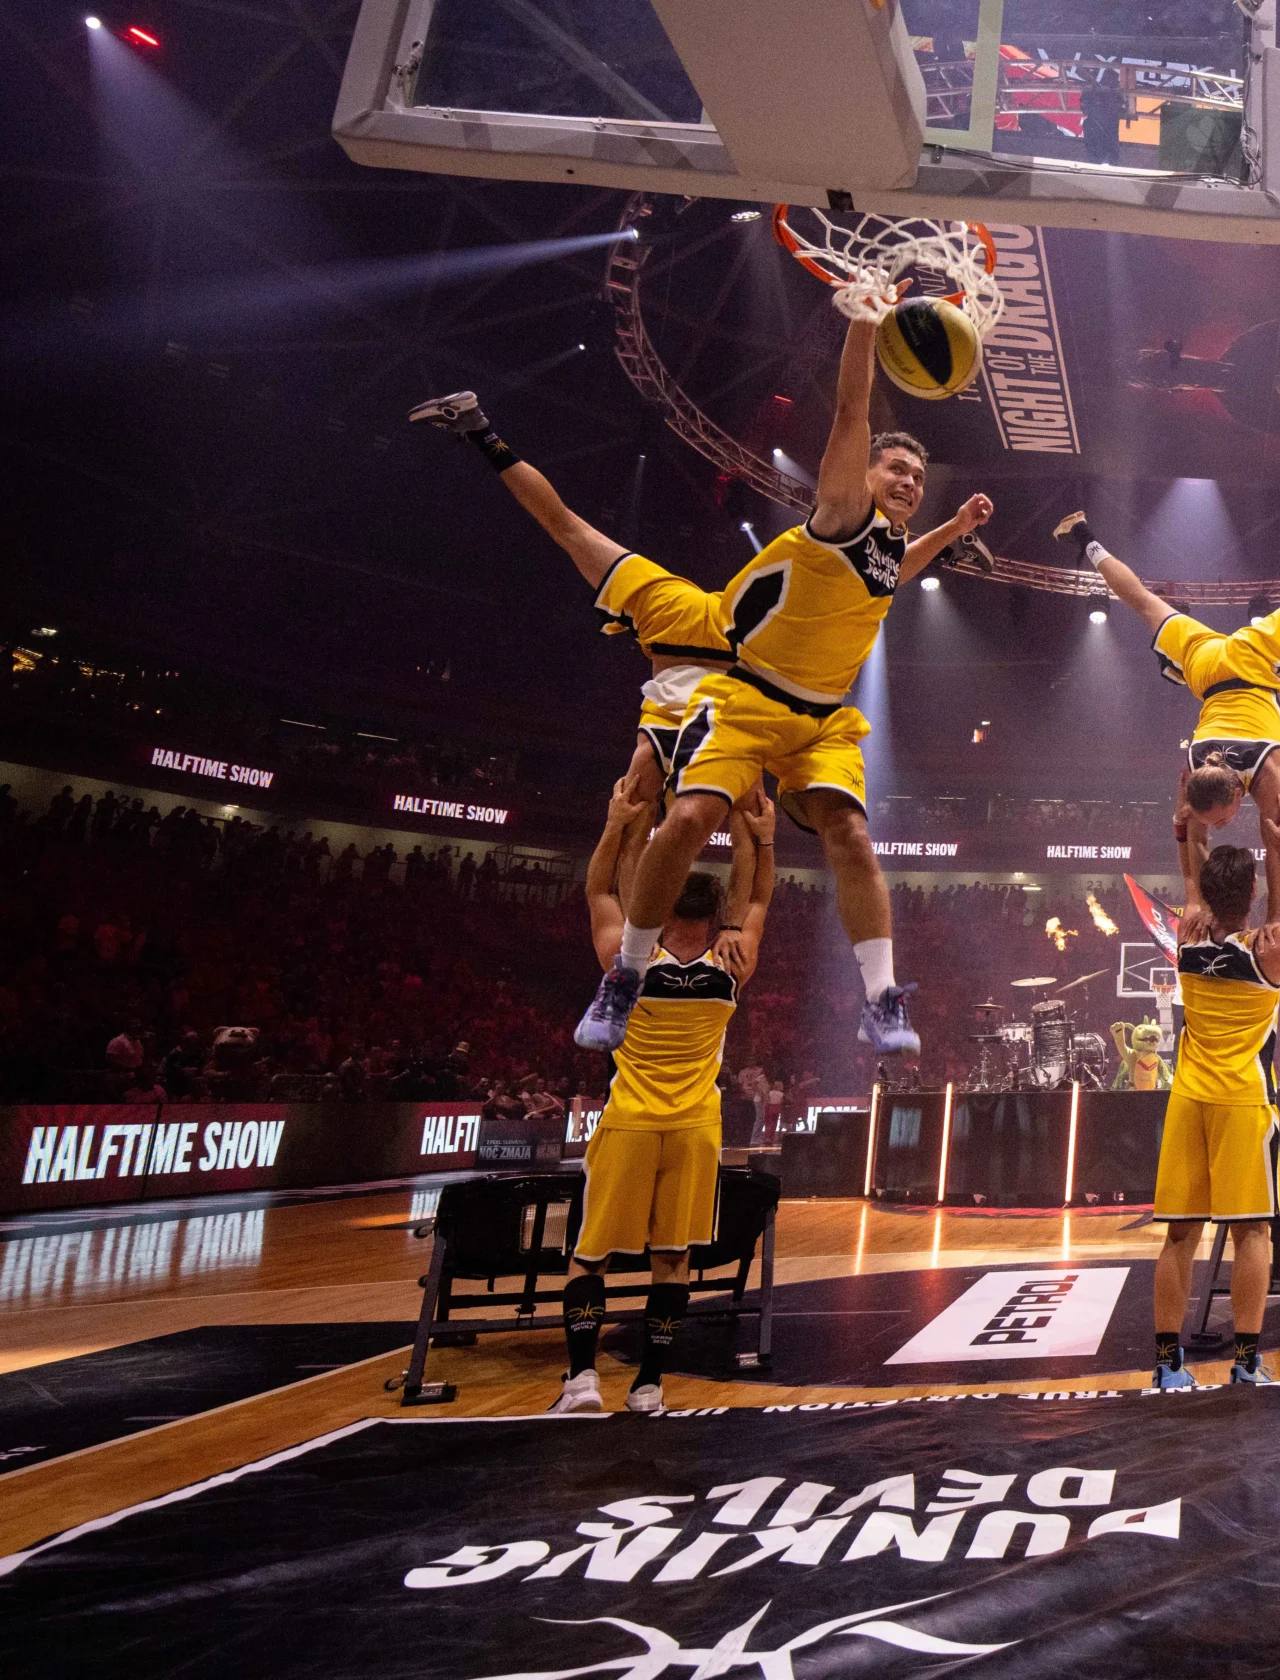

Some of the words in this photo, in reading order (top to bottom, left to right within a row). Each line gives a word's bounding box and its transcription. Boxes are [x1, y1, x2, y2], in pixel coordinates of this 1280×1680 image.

[983, 348, 1026, 371] OF
[1027, 353, 1059, 375] THE
[990, 372, 1074, 454] NIGHT
[151, 748, 228, 779] HALFTIME
[229, 764, 274, 788] SHOW
[394, 795, 465, 819] HALFTIME
[466, 804, 508, 825] SHOW
[924, 843, 958, 856] SHOW
[1046, 845, 1098, 858] HALFTIME
[1099, 846, 1132, 859] SHOW
[420, 1115, 481, 1155] HALFTI
[21, 1122, 199, 1185] HALFTIME
[199, 1120, 285, 1172] SHOW
[969, 1275, 1079, 1345] PETROL
[1017, 1390, 1124, 1401] TRUE
[1140, 1384, 1223, 1396] ONE
[575, 1467, 1117, 1538] DEVILS
